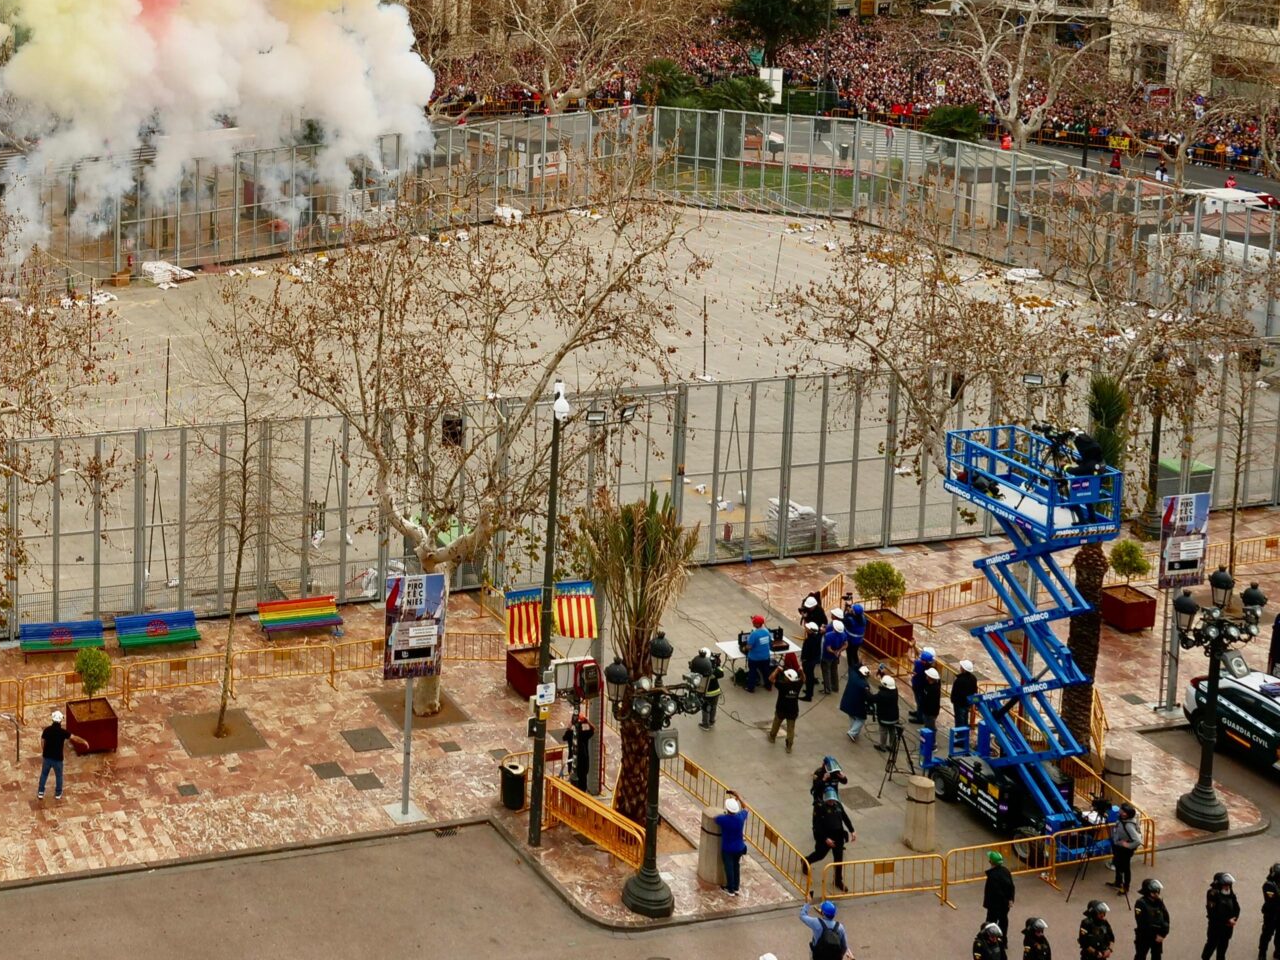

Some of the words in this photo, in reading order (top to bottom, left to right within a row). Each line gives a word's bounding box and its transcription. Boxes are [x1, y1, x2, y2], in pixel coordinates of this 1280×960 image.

[944, 482, 971, 500] mateco
[1055, 528, 1080, 536] mateco
[985, 553, 1011, 566] mateco
[407, 582, 423, 590] PIRO
[406, 598, 423, 606] NIES
[1023, 611, 1049, 624] mateco
[1022, 682, 1048, 694] mateco
[1221, 717, 1251, 738] GUARDIA
[1251, 734, 1269, 749] CIVIL
[958, 782, 972, 796] 4x4
